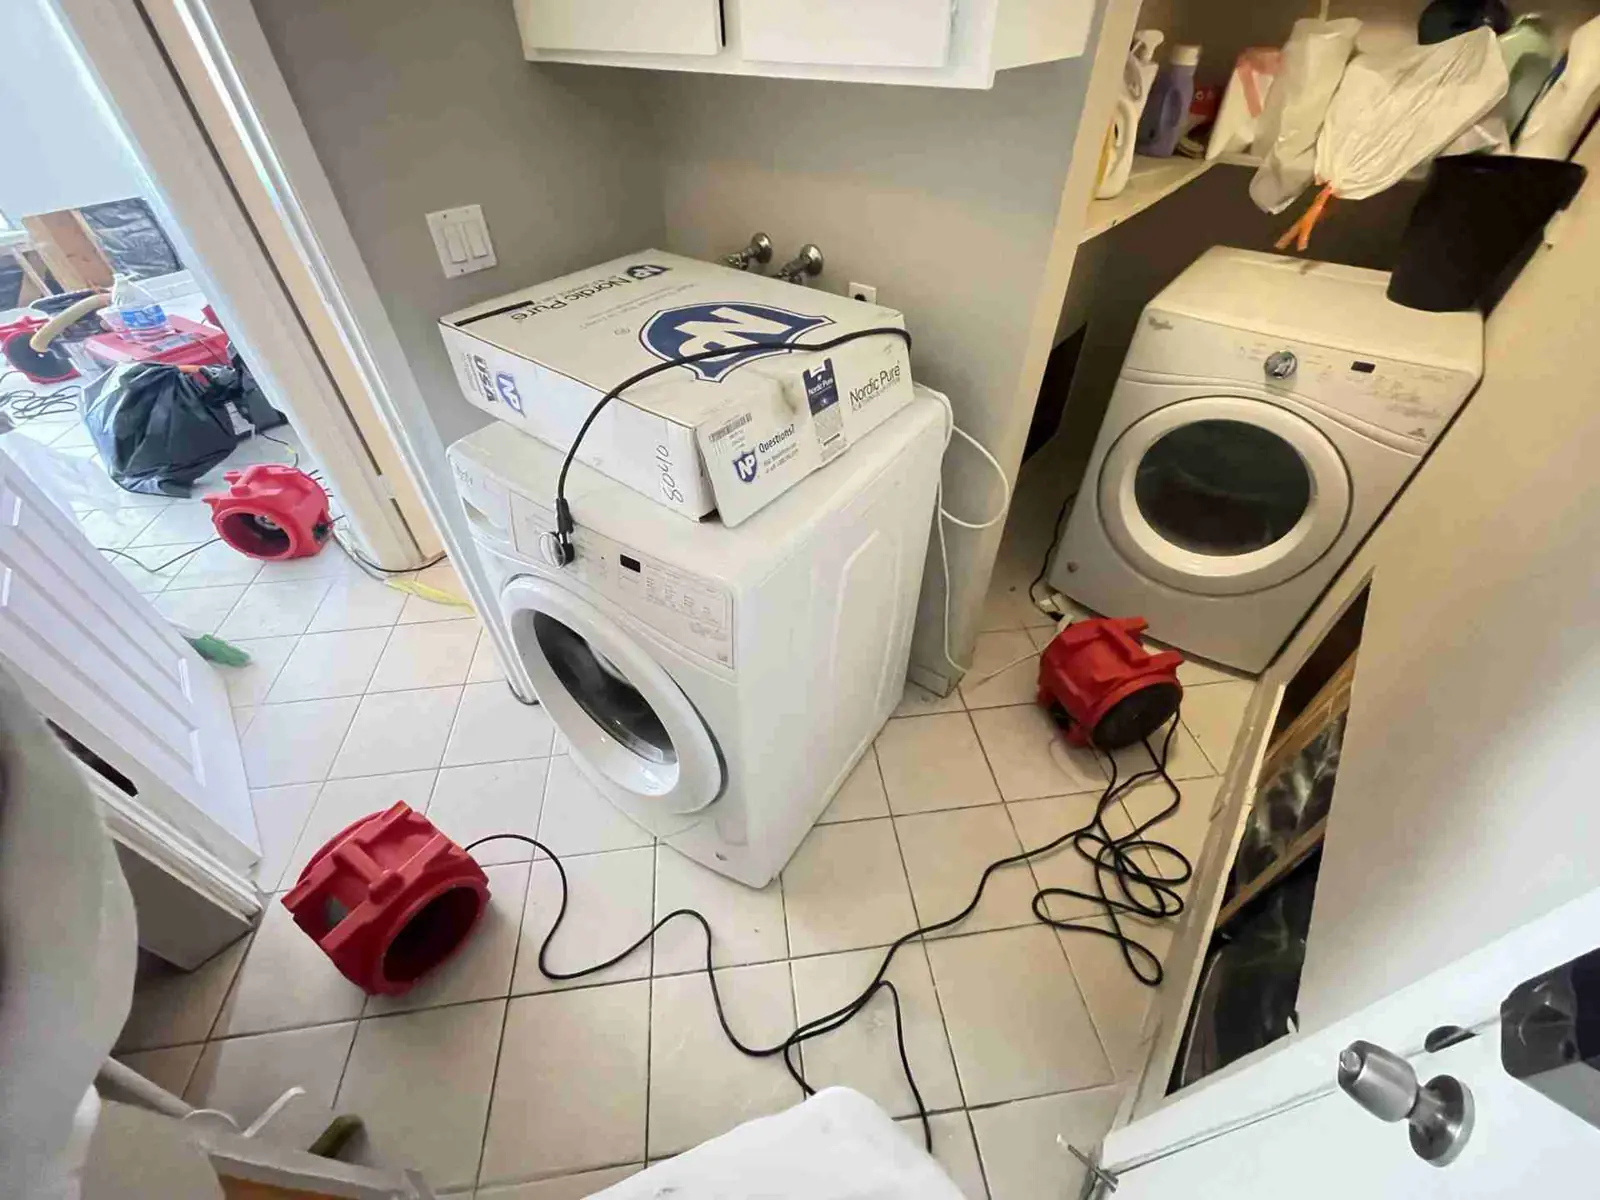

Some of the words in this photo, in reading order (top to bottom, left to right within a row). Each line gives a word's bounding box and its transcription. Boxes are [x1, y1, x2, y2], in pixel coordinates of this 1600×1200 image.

[564, 275, 632, 301] Nordic
[511, 300, 568, 322] Pure
[499, 376, 521, 410] NP
[849, 378, 879, 406] Nordic
[880, 364, 900, 385] Pure
[759, 424, 795, 453] Questions?
[737, 454, 756, 479] NP
